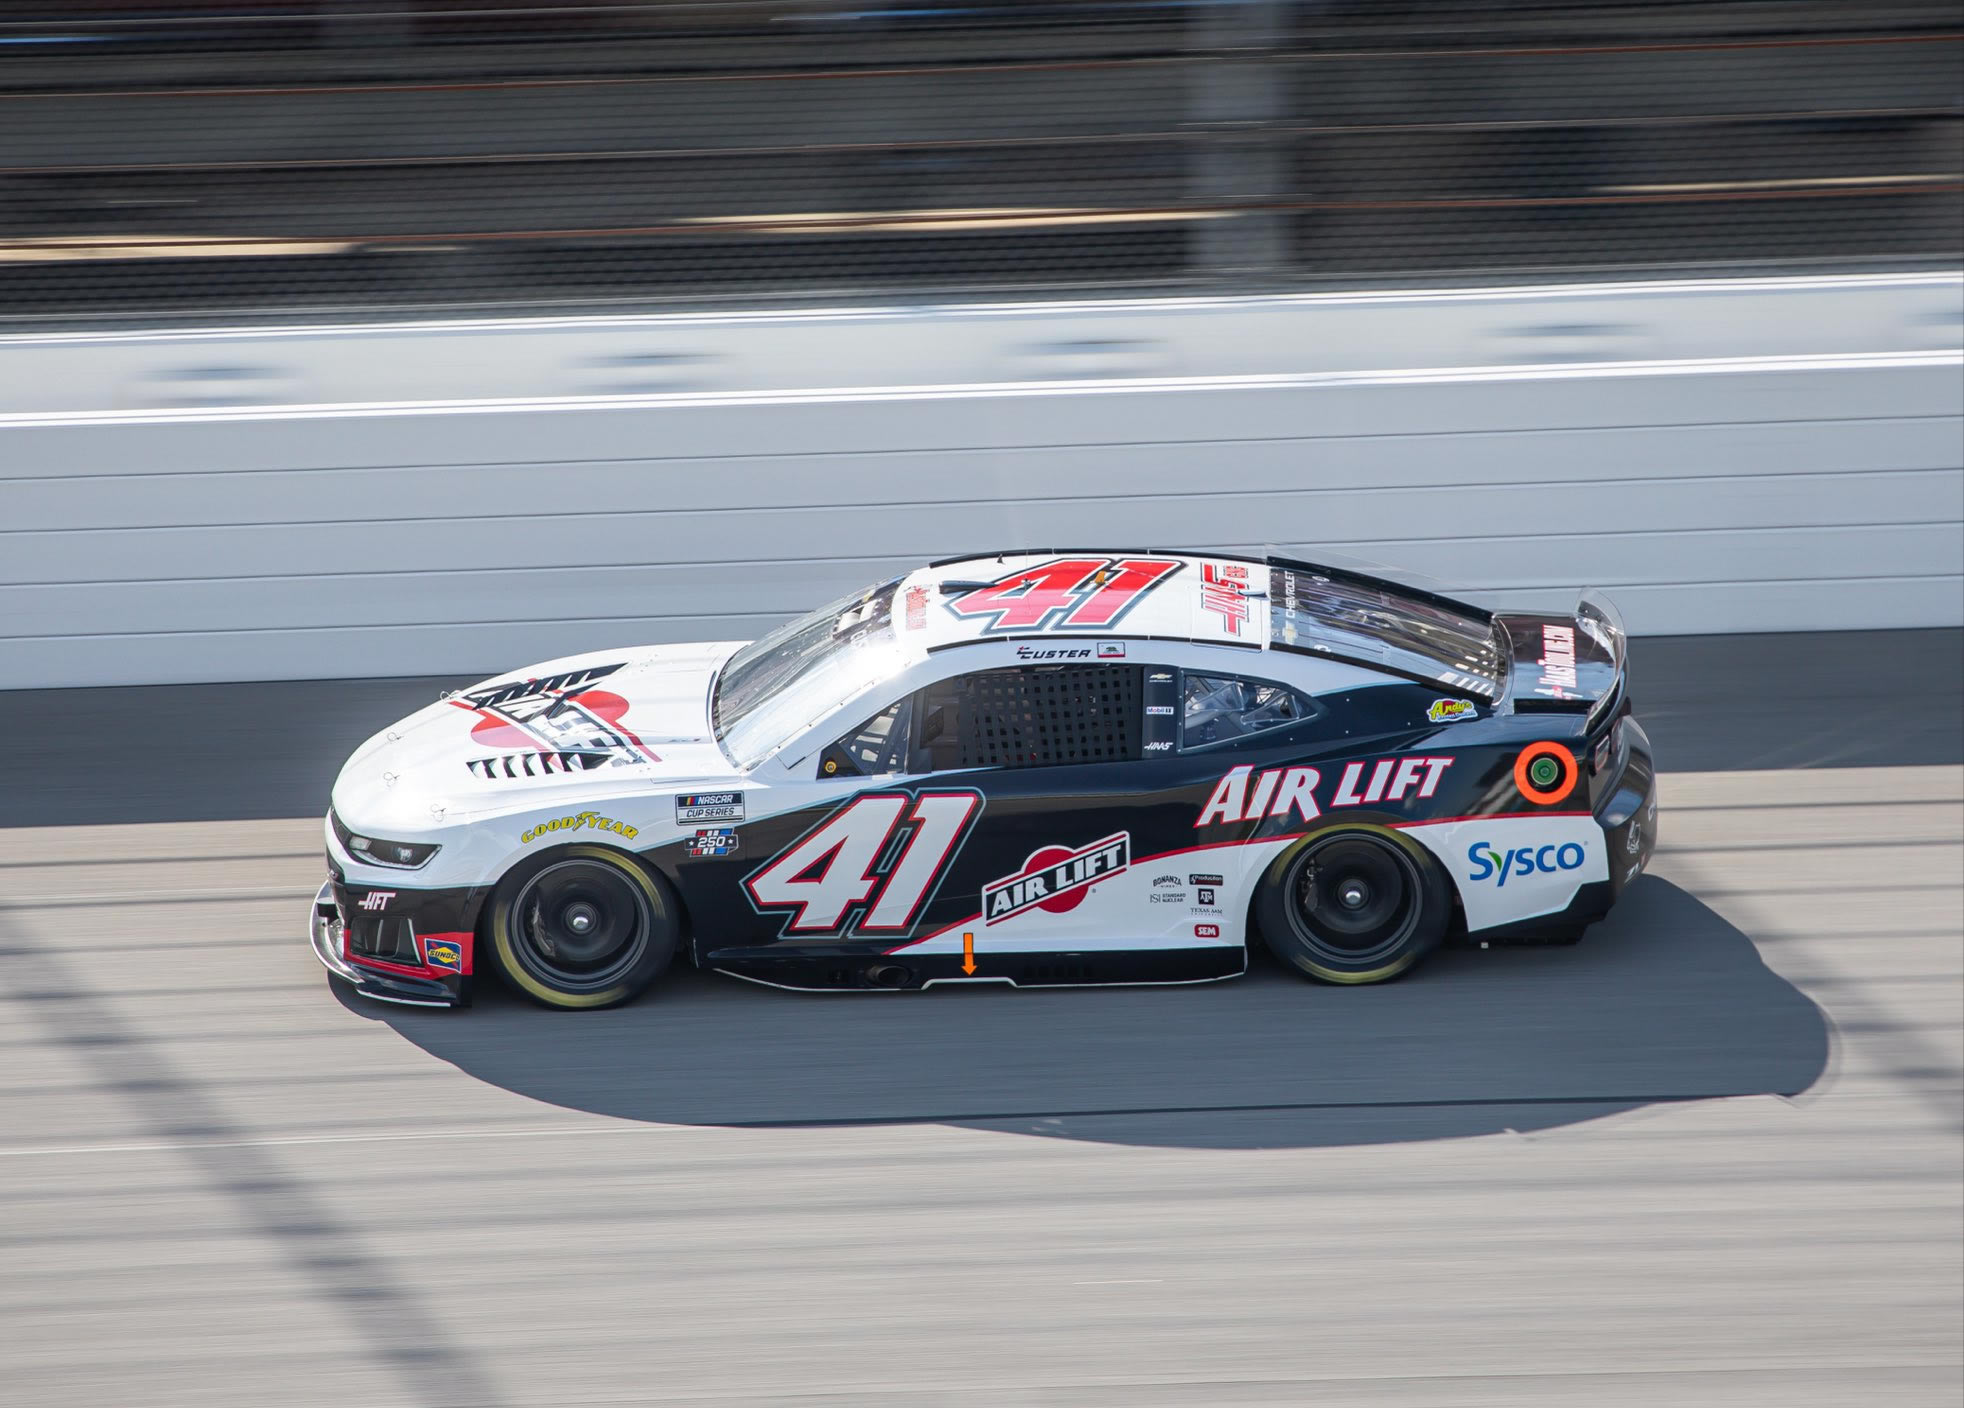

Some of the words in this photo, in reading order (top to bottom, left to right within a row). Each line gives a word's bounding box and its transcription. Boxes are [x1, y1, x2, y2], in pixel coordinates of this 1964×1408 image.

[948, 559, 1184, 630] 41
[1284, 571, 1296, 618] CHEVROLET
[698, 795, 733, 805] NASCAR
[1193, 764, 1322, 828] AIR
[1330, 756, 1456, 808] LIFT
[686, 809, 704, 818] CUP
[704, 807, 734, 817] SERIES
[521, 813, 639, 844] GOODYEAR
[697, 836, 726, 848] 250
[744, 792, 979, 930] 41
[990, 876, 1049, 917] AIR
[1055, 844, 1122, 888] LIFT
[1153, 875, 1182, 887] BONANZA
[1198, 927, 1216, 935] SEM
[428, 949, 460, 961] SUNOCO
